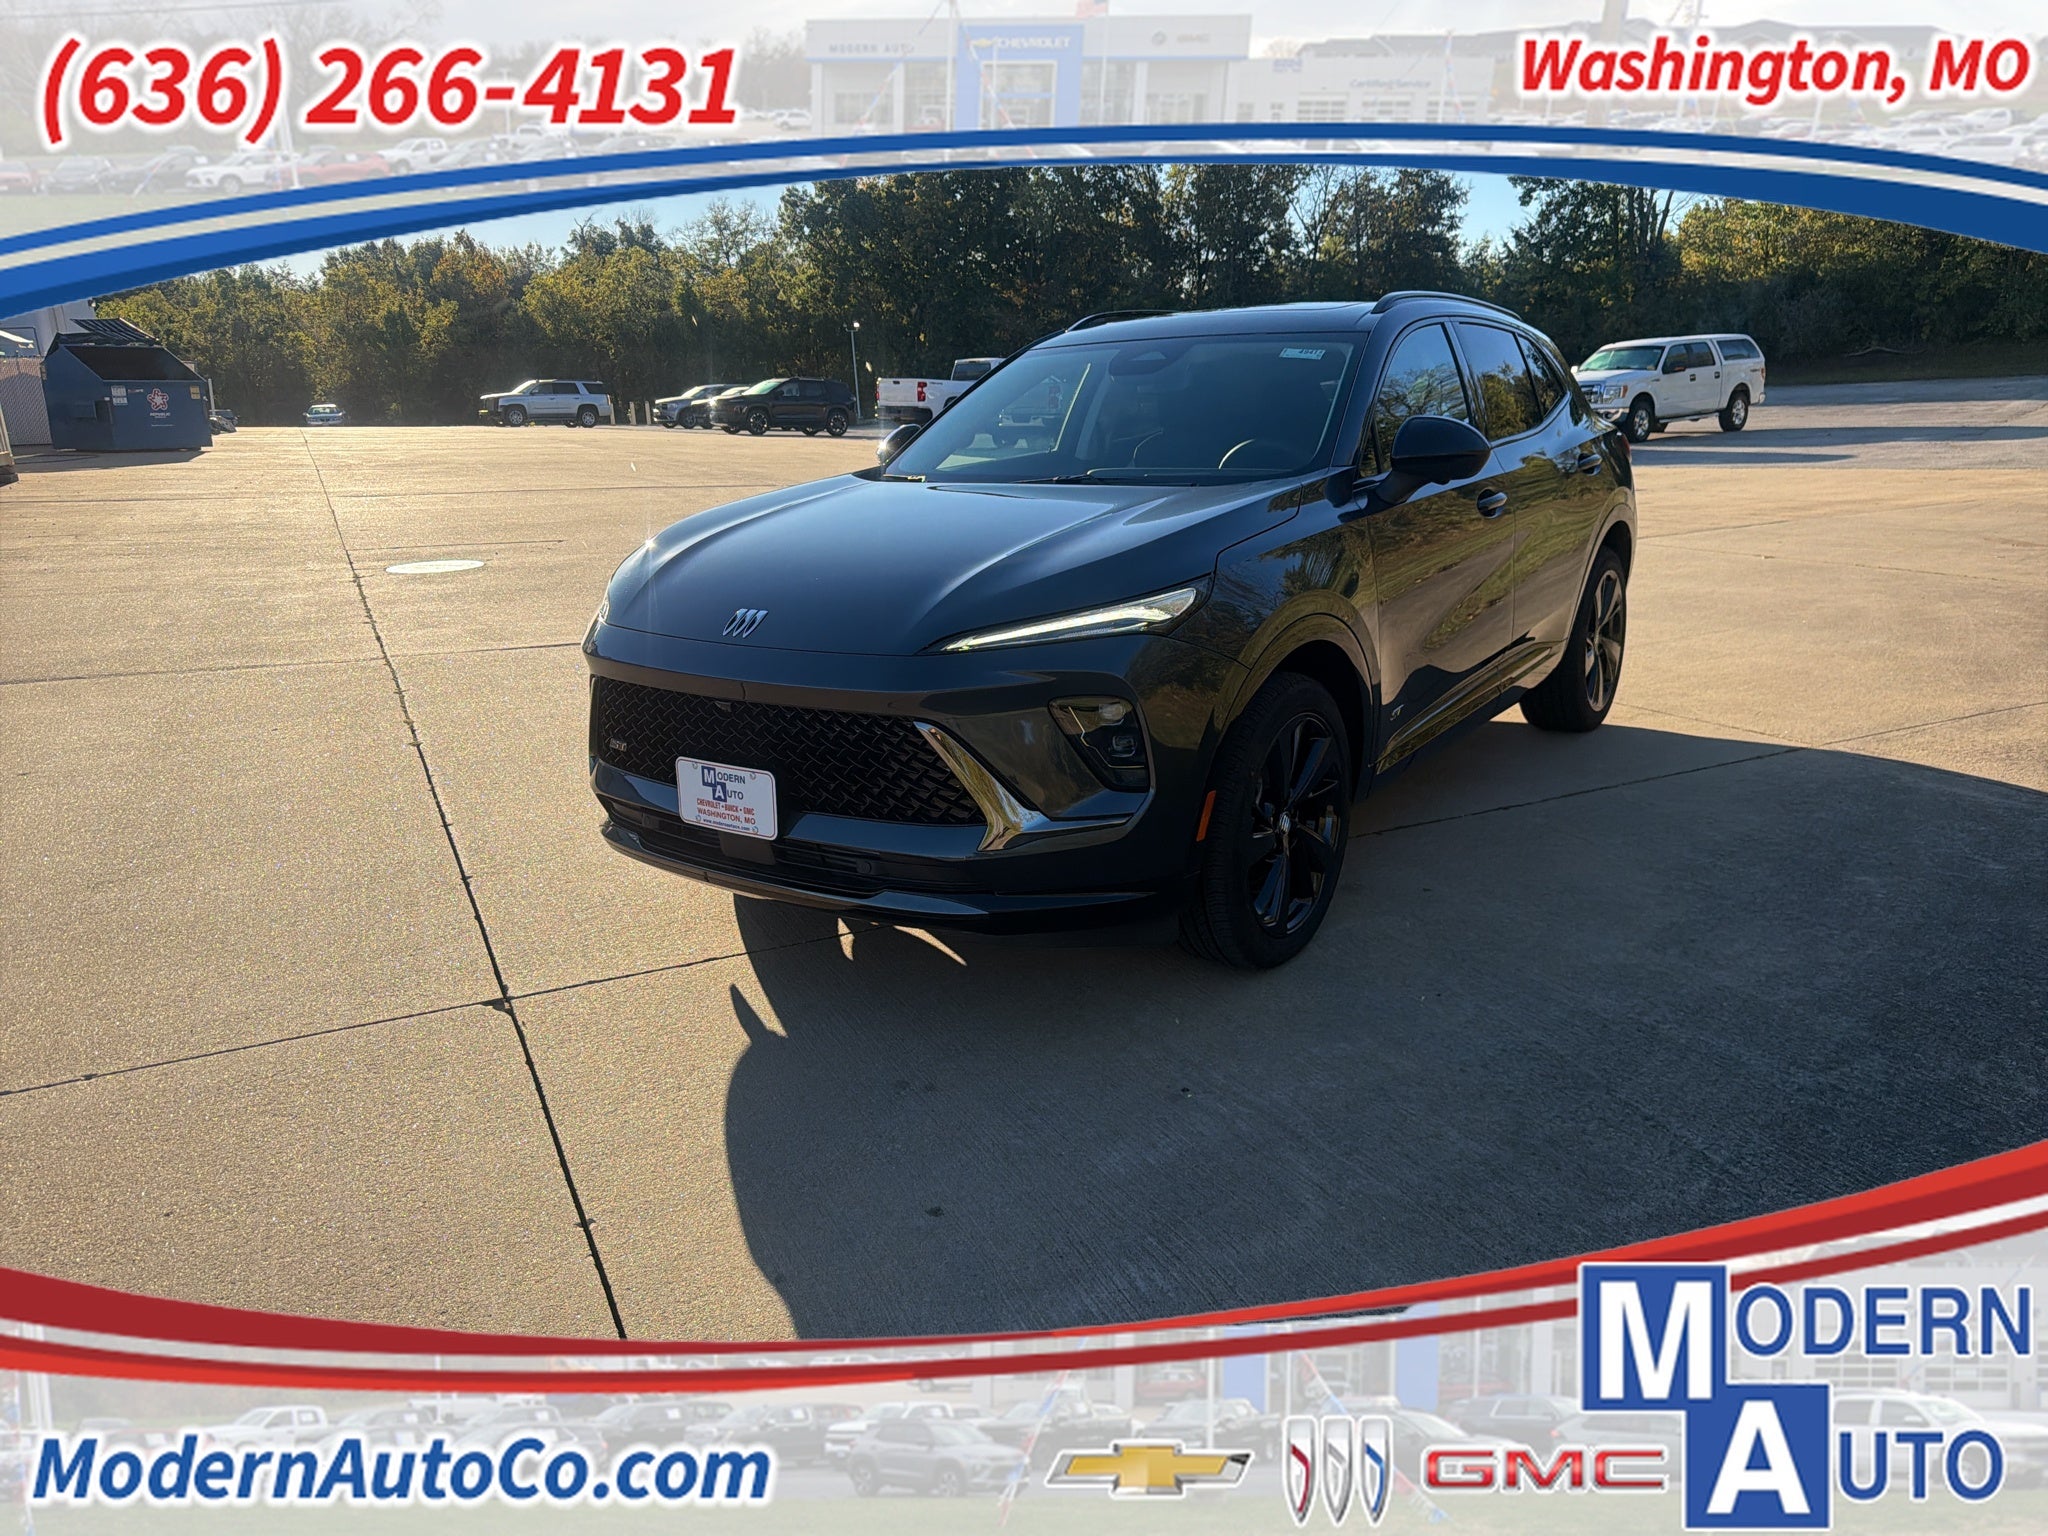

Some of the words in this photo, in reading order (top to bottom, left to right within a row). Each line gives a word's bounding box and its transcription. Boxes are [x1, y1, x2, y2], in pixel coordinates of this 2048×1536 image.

[703, 768, 746, 785] MODERN
[715, 784, 744, 800] AUTO
[697, 797, 721, 809] CHEVROLET
[744, 816, 756, 825] MO
